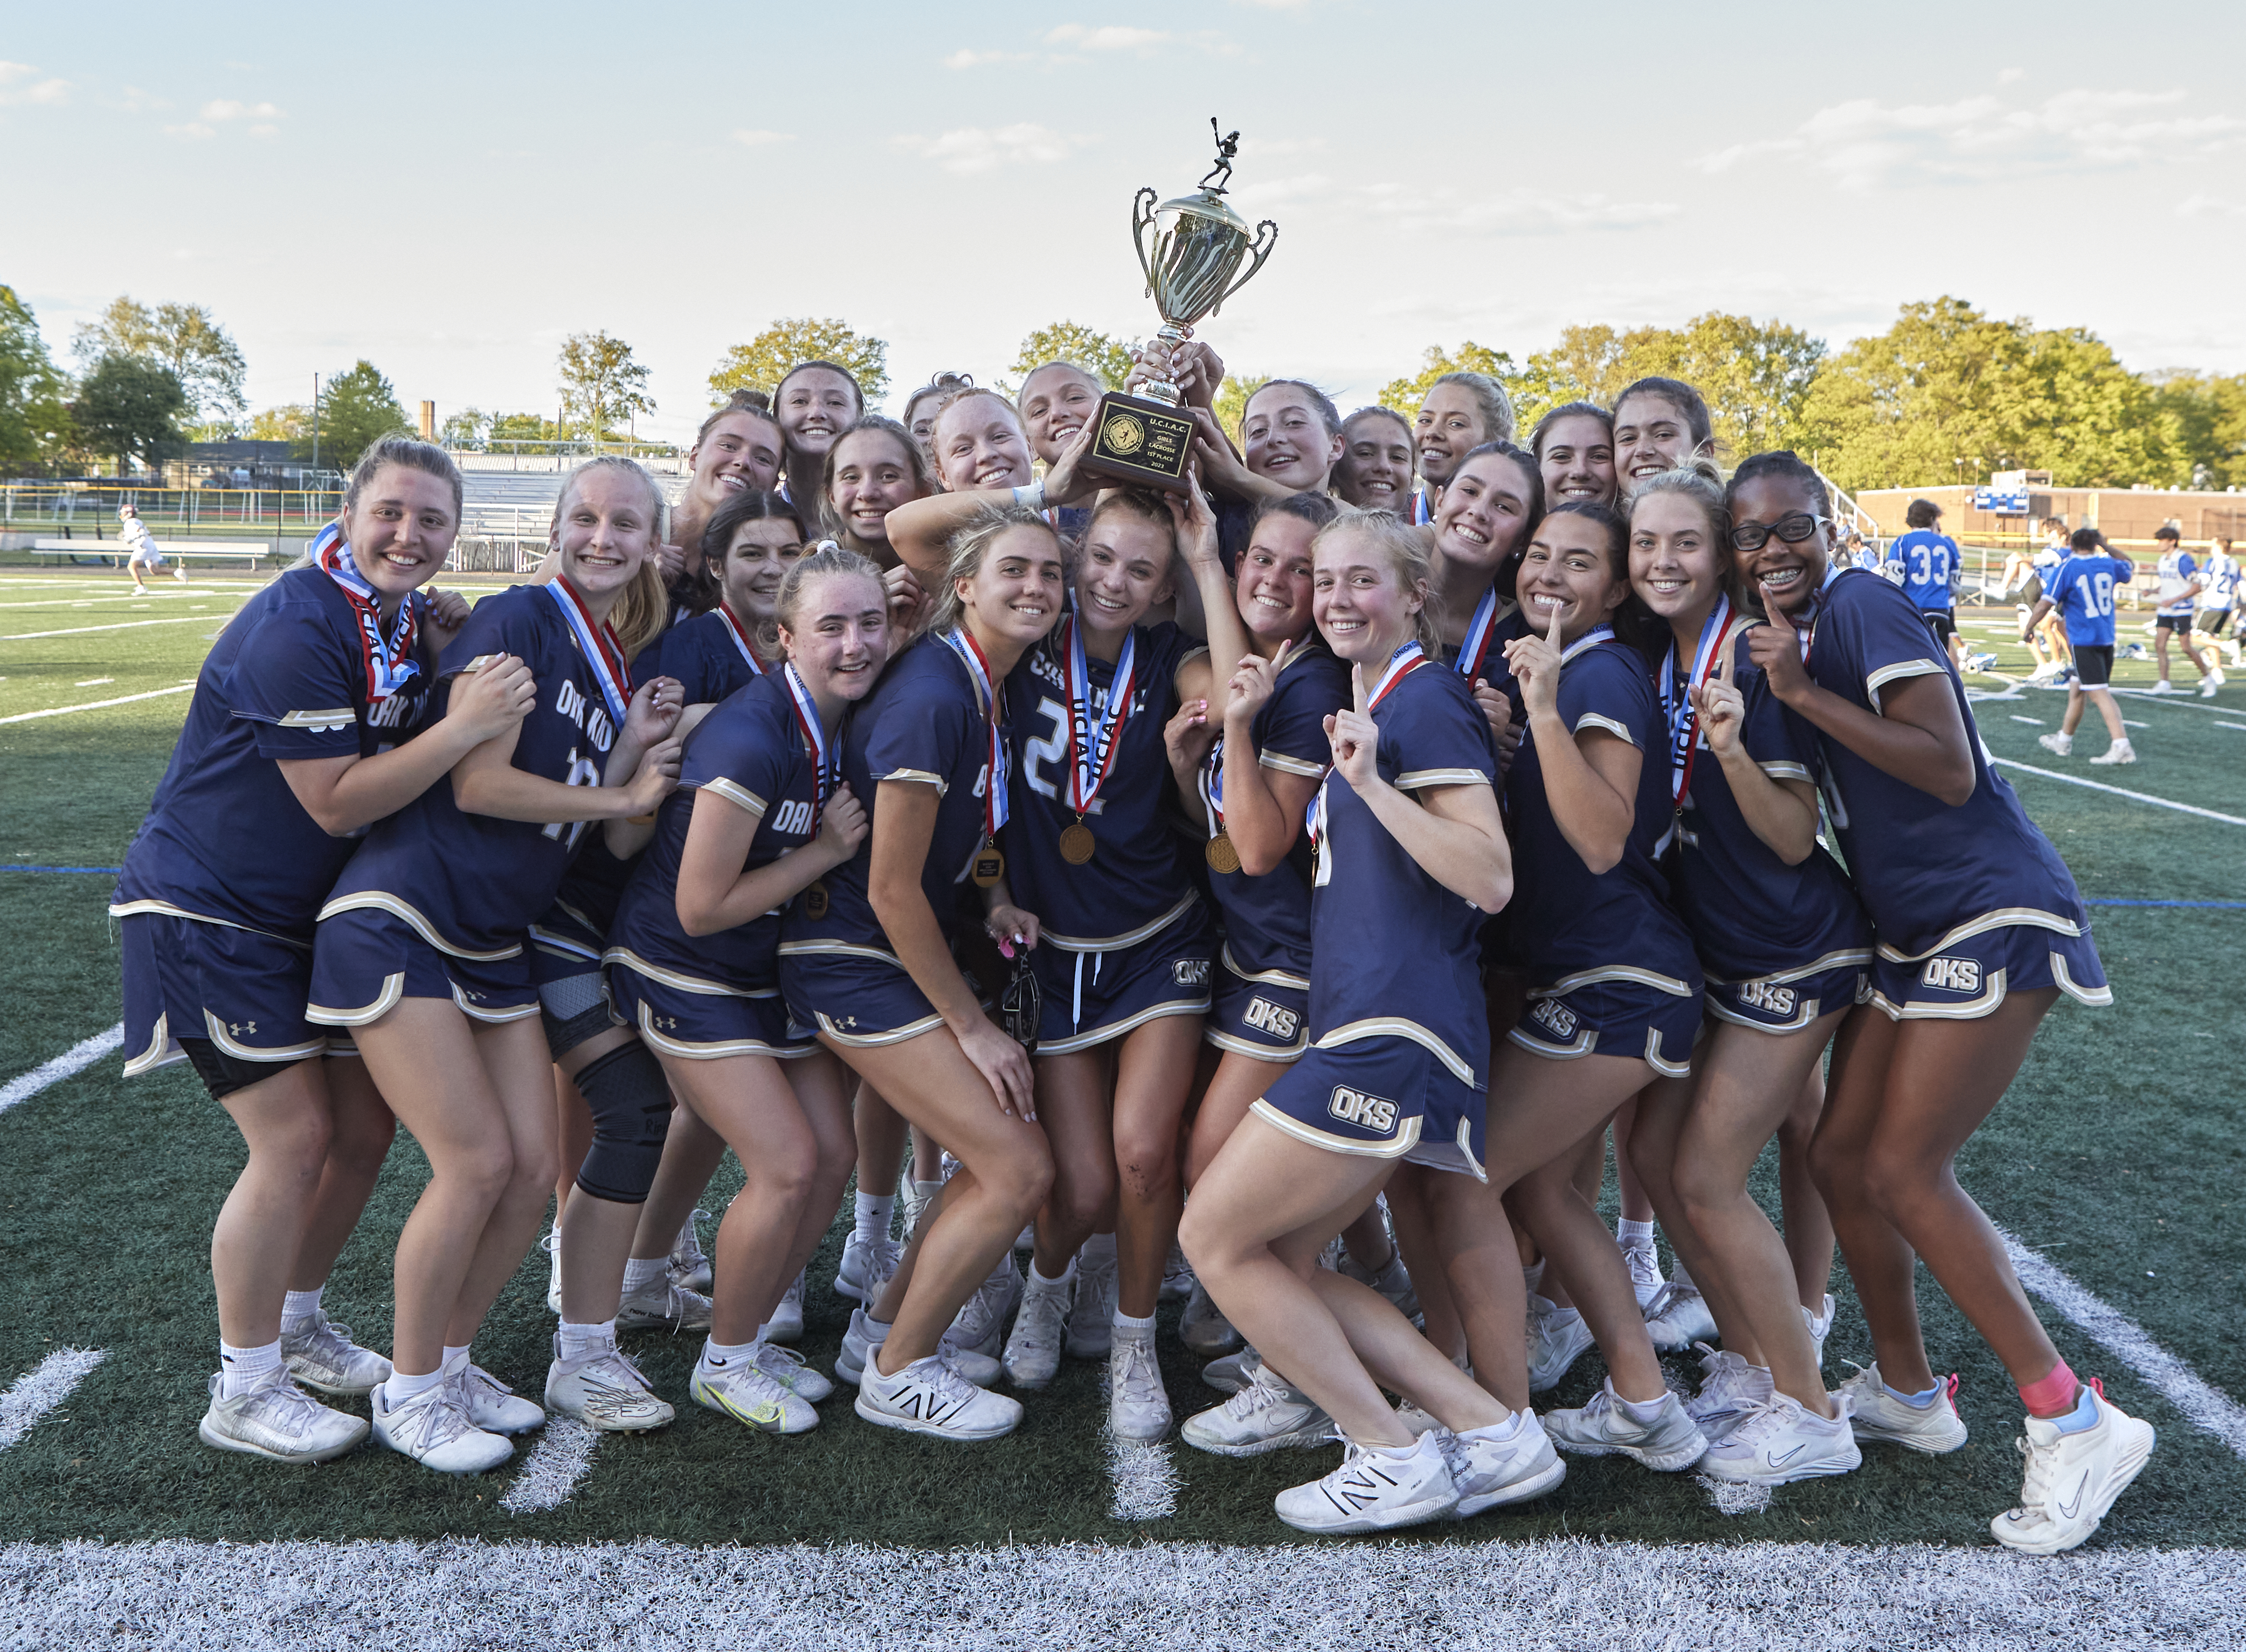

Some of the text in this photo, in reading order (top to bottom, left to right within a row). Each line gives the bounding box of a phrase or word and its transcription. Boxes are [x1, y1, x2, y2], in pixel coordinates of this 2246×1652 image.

[1150, 418, 1186, 433] U.C.I.A.C.
[1149, 443, 1176, 453] LACROSSE
[1156, 453, 1174, 462] PLACE
[1911, 544, 1950, 585] 33
[2076, 572, 2113, 619] 18
[1393, 644, 1413, 659] UNION
[367, 694, 409, 727] OAK
[1071, 698, 1089, 773] UCIAC
[1092, 706, 1123, 779] UCIAC
[1175, 960, 1211, 985] OKS
[1924, 958, 1979, 991] OKS
[1740, 983, 1795, 1014] OKS
[1244, 998, 1297, 1038] OKS
[1532, 998, 1577, 1036] OKS
[1331, 1088, 1396, 1131] OKS
[629, 1308, 647, 1316] new
